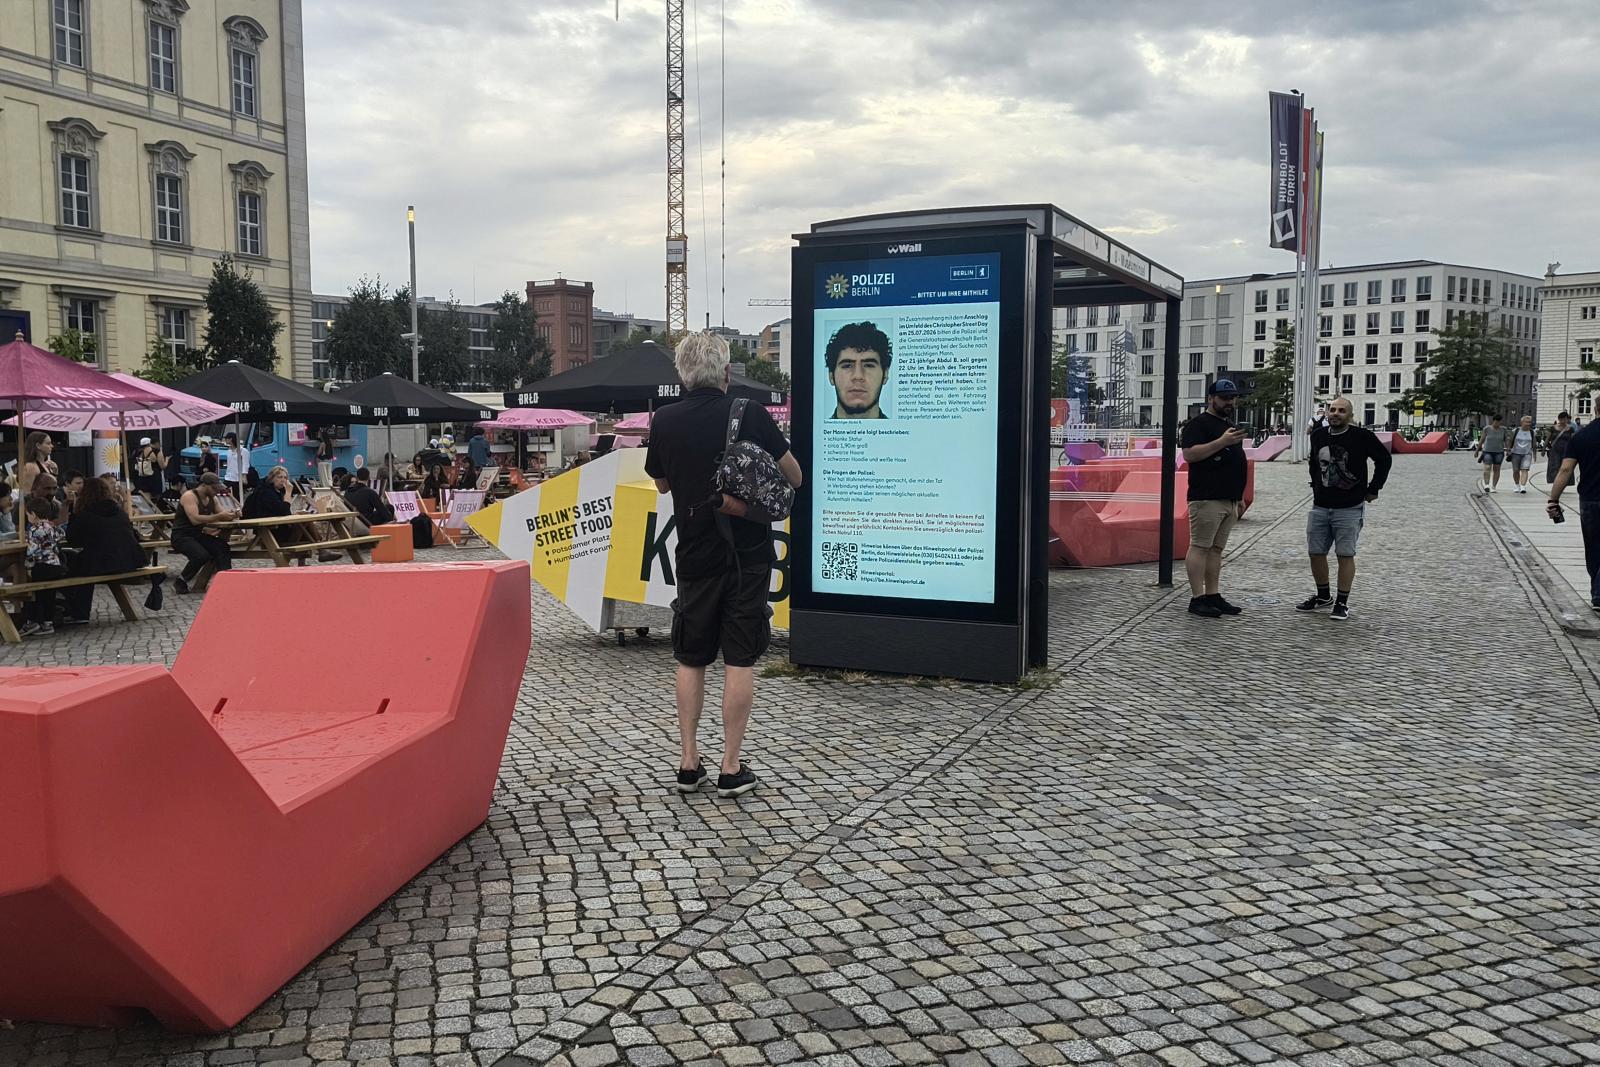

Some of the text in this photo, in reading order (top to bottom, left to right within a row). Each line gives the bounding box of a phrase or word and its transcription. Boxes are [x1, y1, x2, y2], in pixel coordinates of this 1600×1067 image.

[1278, 142, 1288, 202] HUMBOLDT
[1287, 165, 1295, 203] FORUM
[899, 244, 922, 252] Wall
[852, 273, 894, 286] POLIZEI
[852, 287, 880, 296] BERLIN
[44, 385, 125, 398] KERB
[395, 503, 414, 512] KERB
[526, 496, 612, 532] BERLIN'S BEST
[536, 515, 612, 547] STREET FOOD
[552, 535, 610, 554] Potsdamer Platz
[554, 544, 613, 564] Humboldt Forum
[640, 512, 791, 602] KB
